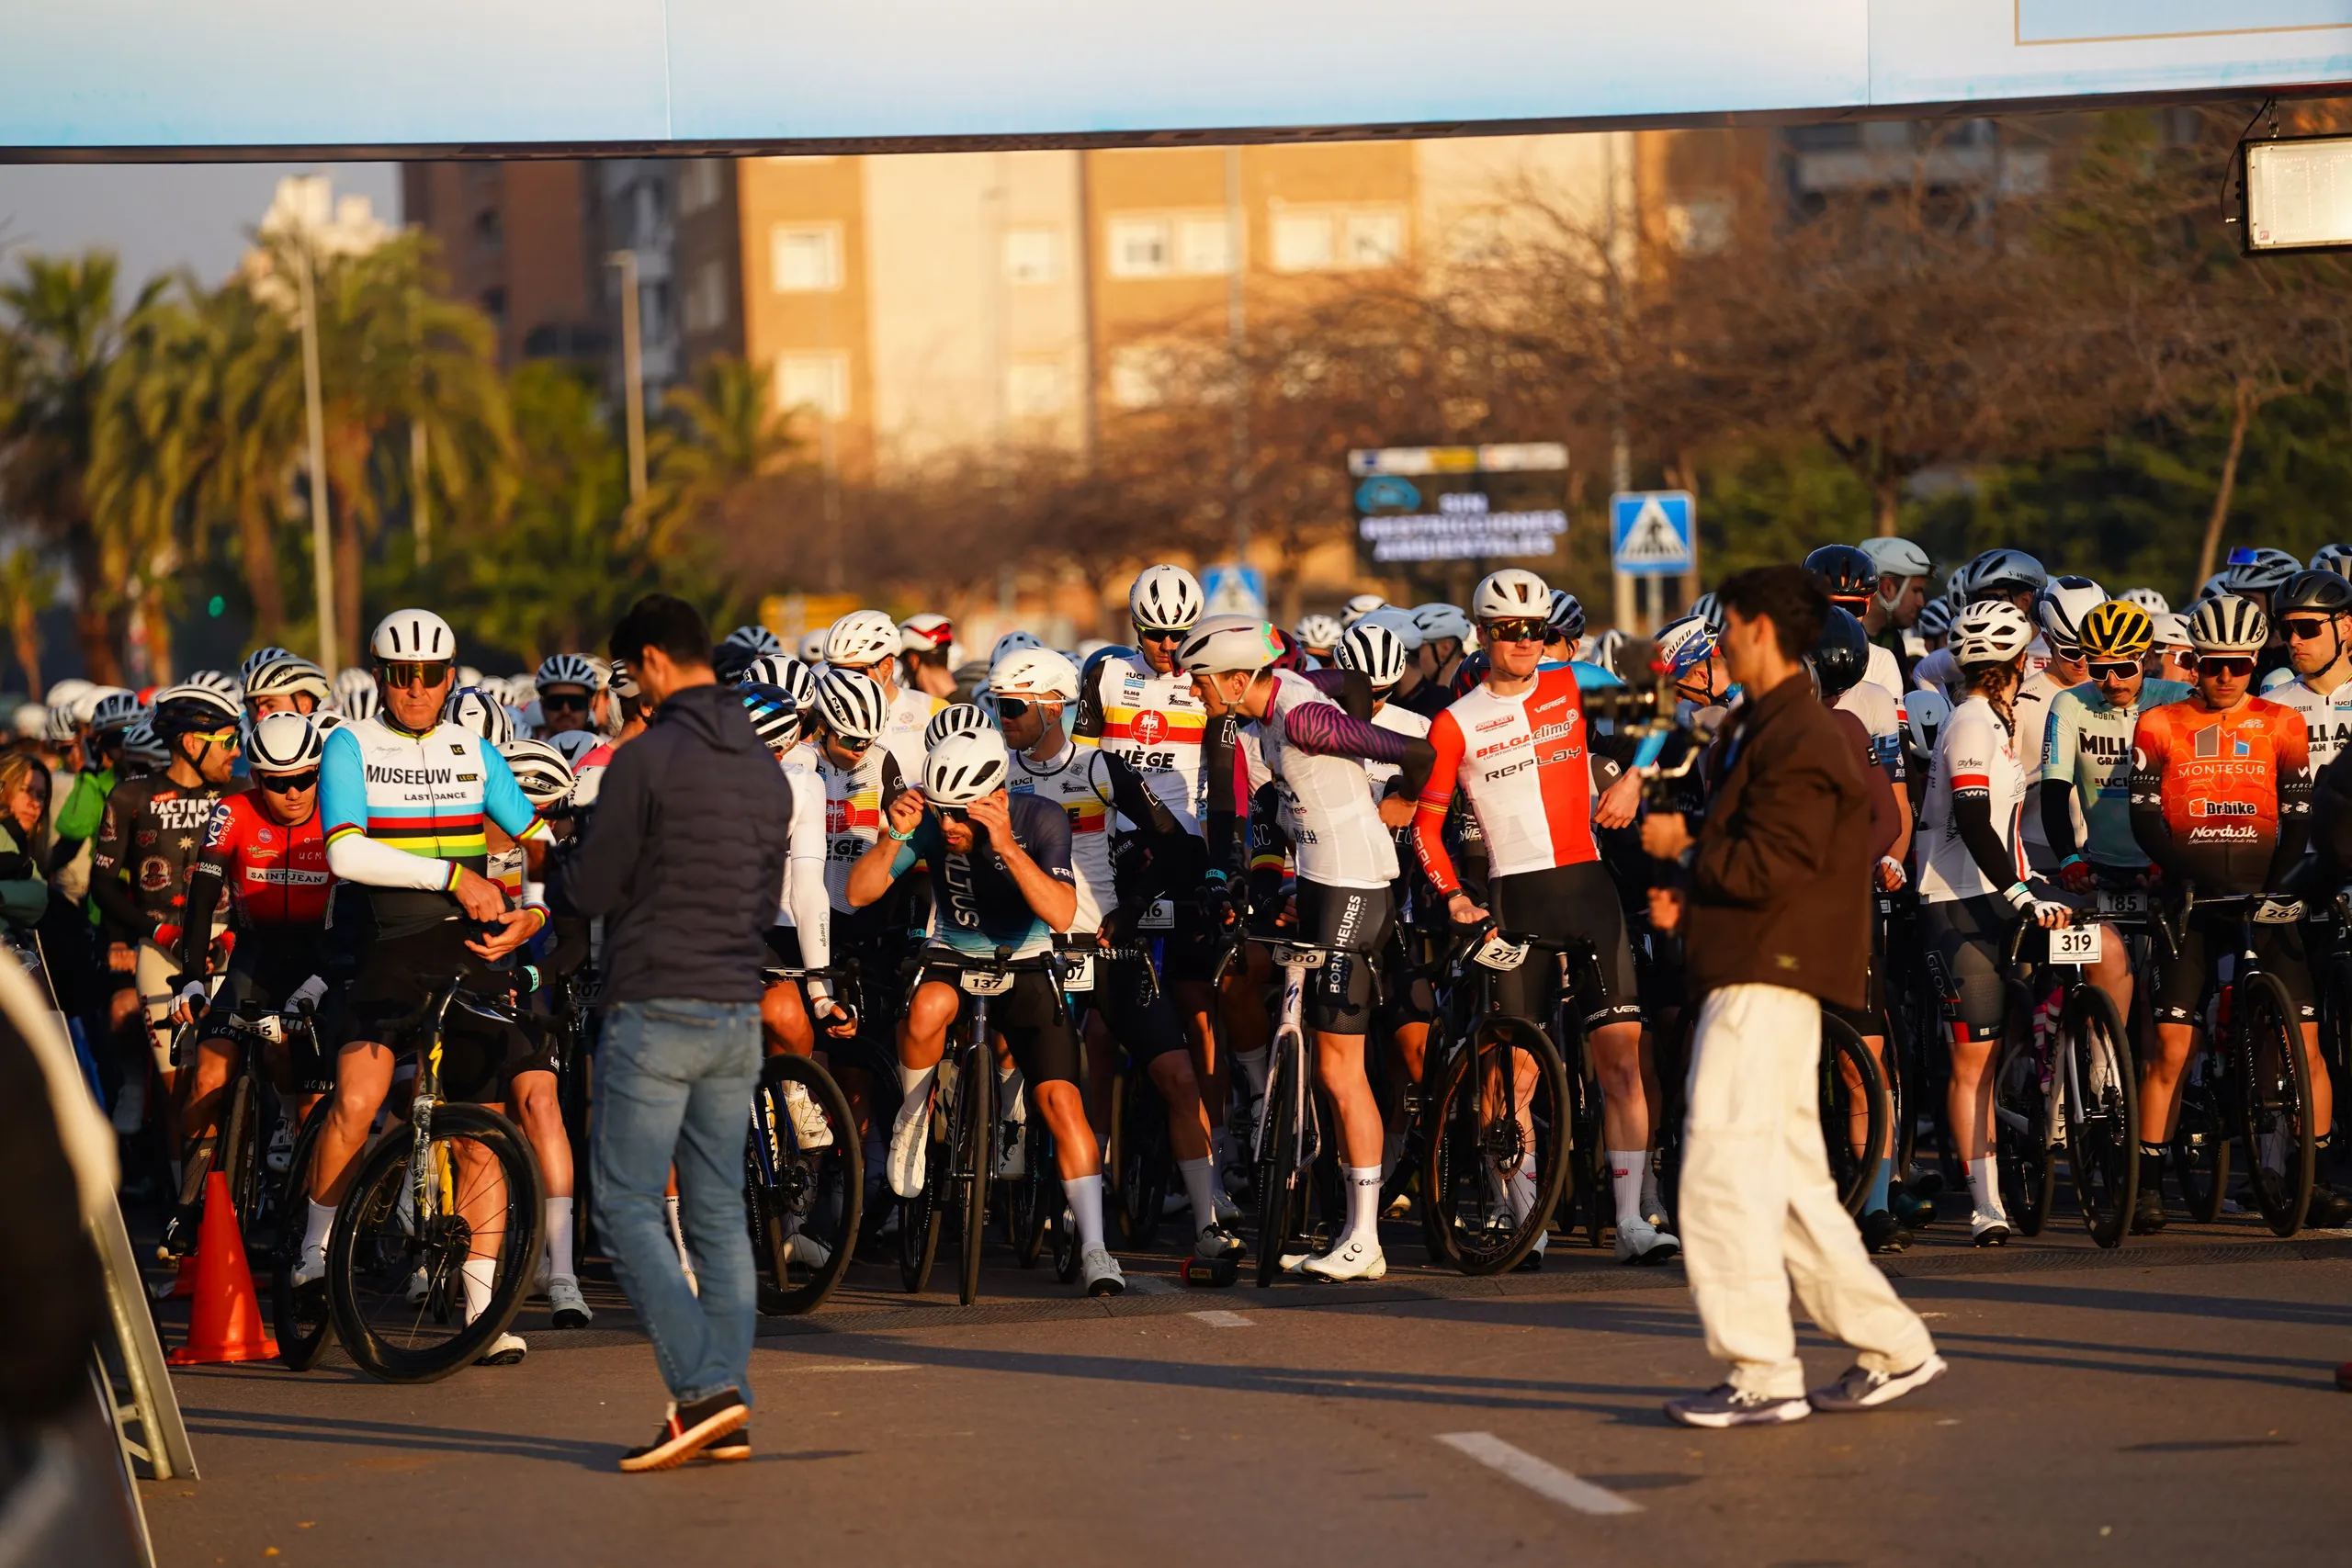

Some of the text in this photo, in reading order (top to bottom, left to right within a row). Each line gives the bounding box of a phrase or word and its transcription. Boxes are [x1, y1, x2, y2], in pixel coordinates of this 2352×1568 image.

[1129, 671, 1146, 681] UCI
[831, 697, 850, 724] MET
[1534, 695, 1567, 713] VERGE
[767, 735, 788, 747] ANYON
[2098, 757, 2128, 766] GRAN
[366, 764, 451, 785] MUSEEUW
[2178, 764, 2266, 779] MONTESUR
[1013, 776, 1033, 785] UCI
[435, 792, 467, 801] DANCE
[160, 813, 210, 830] TEAM
[219, 816, 235, 846] SOYONS
[199, 862, 223, 873] RAMPA
[2108, 895, 2138, 911] 185
[2062, 934, 2092, 952] 319
[1282, 952, 1317, 964] 300
[1489, 948, 1521, 964] 272
[973, 978, 1003, 989] 137
[1928, 953, 1948, 999] GEOX
